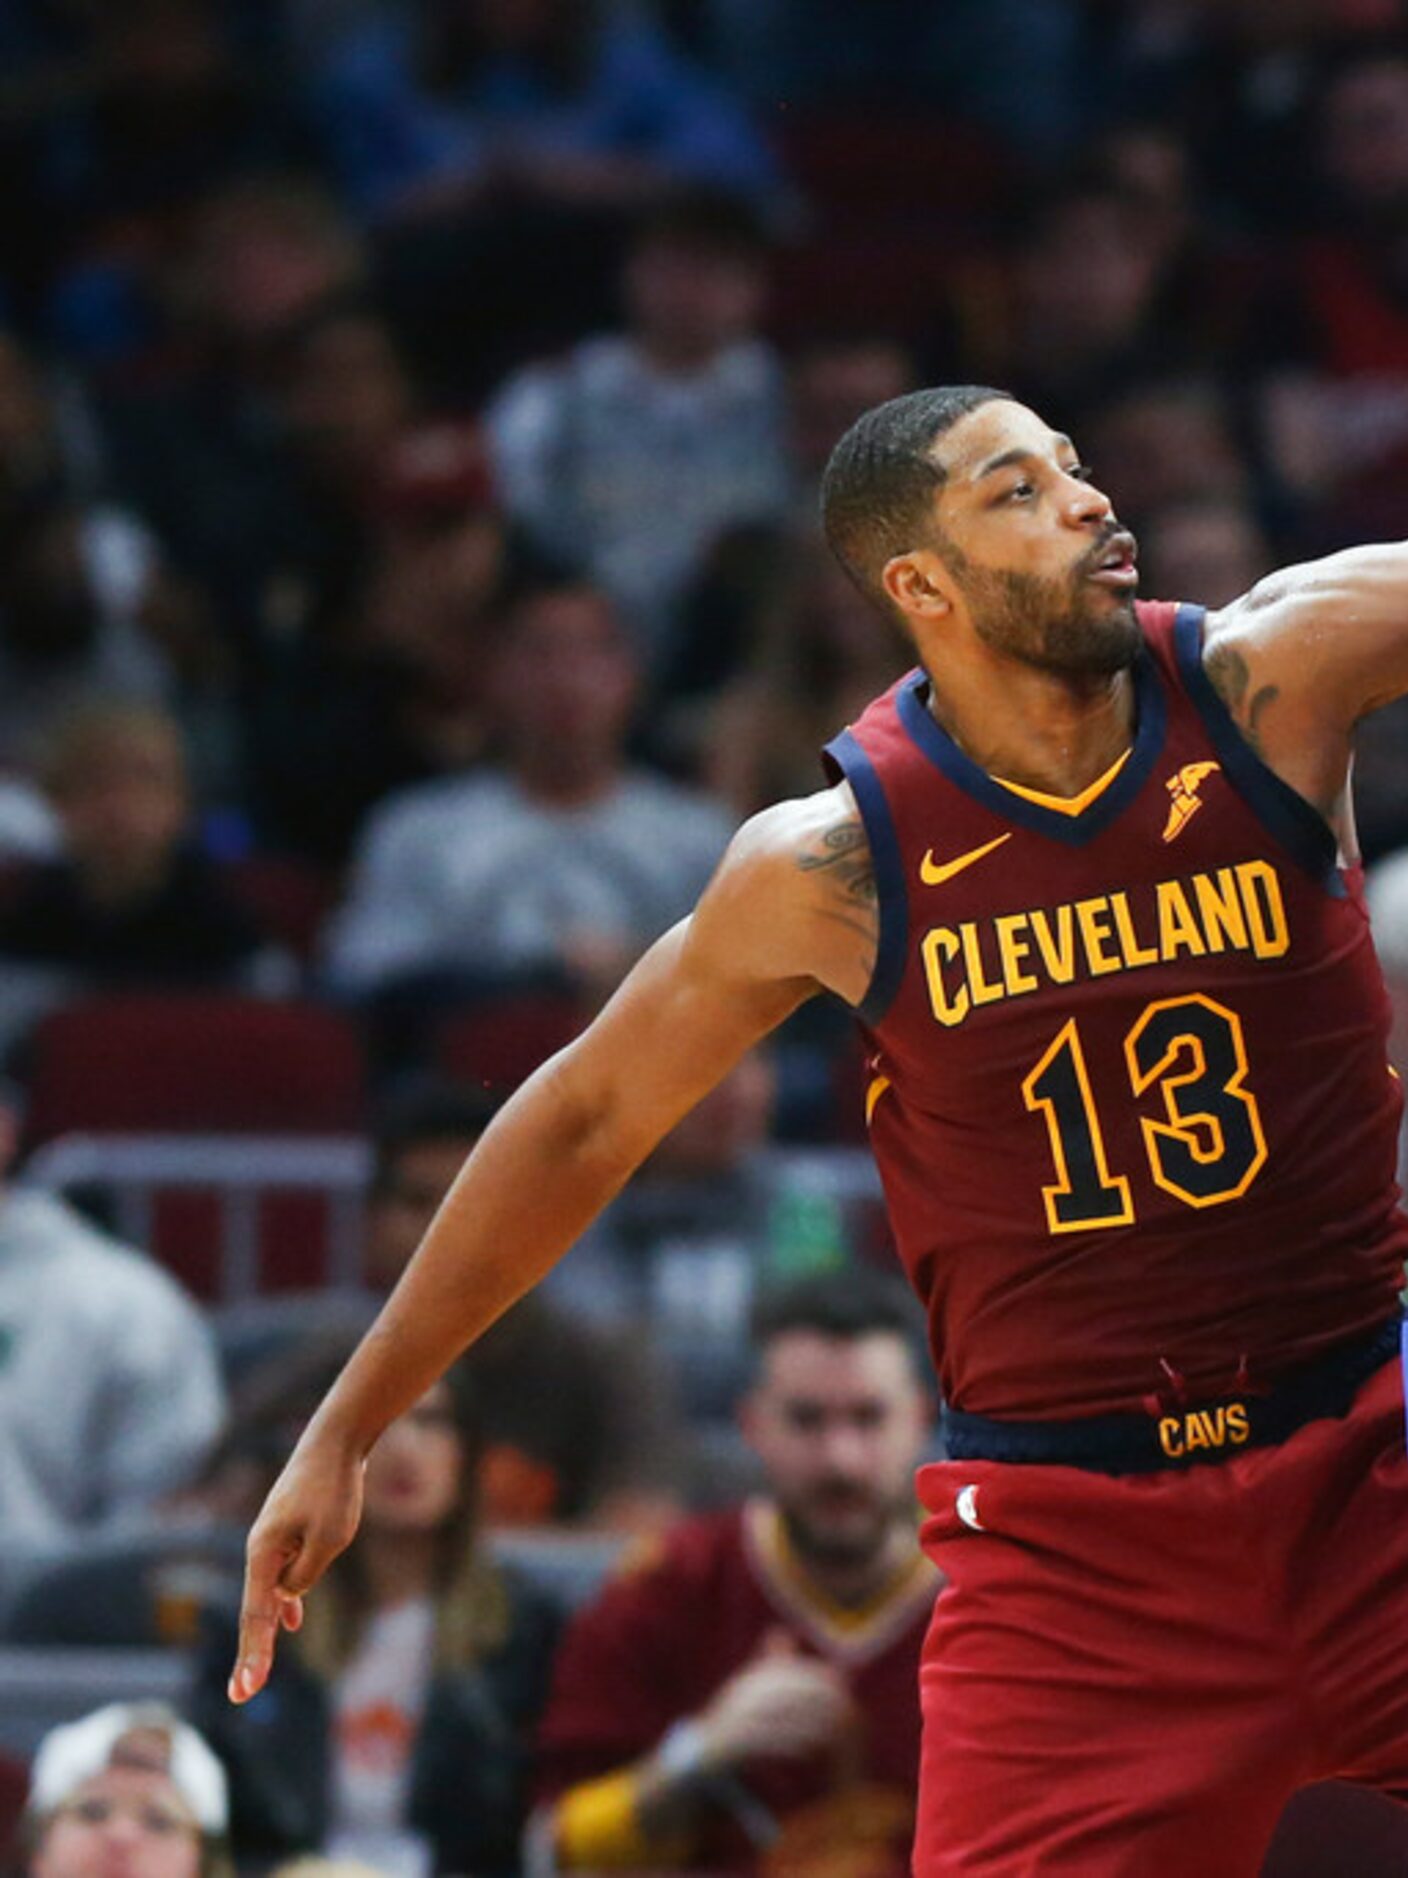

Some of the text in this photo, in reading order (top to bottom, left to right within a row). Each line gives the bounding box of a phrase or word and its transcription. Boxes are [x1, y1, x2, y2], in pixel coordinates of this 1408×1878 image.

[920, 859, 1291, 1027] CLEVELAND
[1021, 992, 1269, 1235] 13
[1159, 1402, 1250, 1458] CAVS
